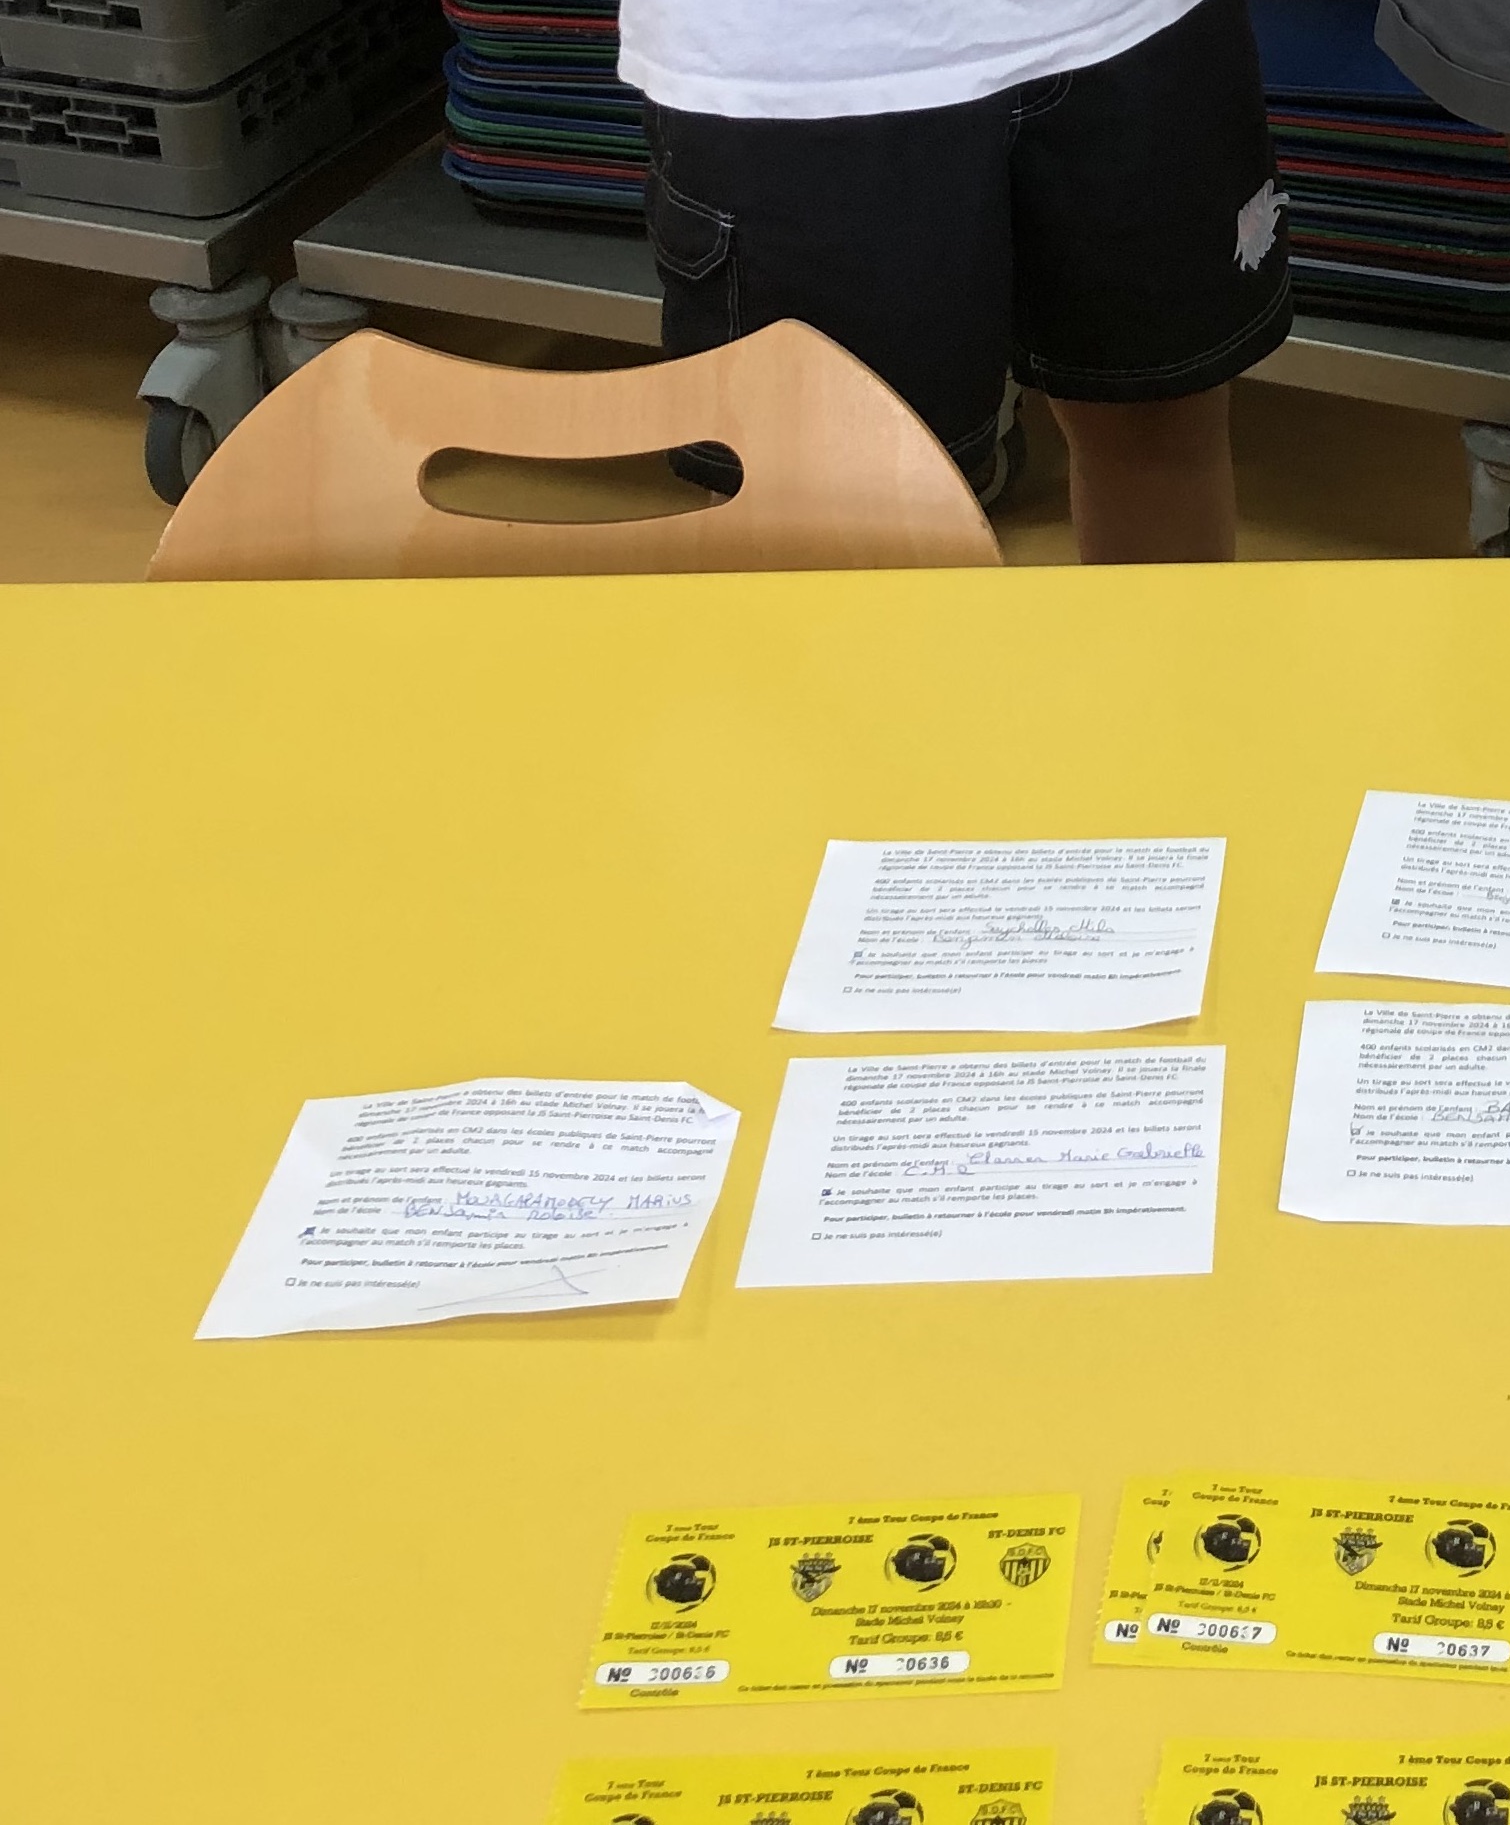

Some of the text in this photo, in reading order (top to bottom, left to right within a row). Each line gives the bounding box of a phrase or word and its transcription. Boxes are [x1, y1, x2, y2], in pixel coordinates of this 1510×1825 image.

[1311, 1508, 1414, 1523] JS ST-PIERROISE
[988, 1527, 1066, 1539] ST-DENIS FC
[768, 1534, 874, 1548] JS ST-PIERROISE
[957, 1780, 1044, 1796] ST-DENIS FC
[1315, 1775, 1428, 1788] JS ST-PIERROISE
[718, 1790, 834, 1807] JS ST-PIERROISE
